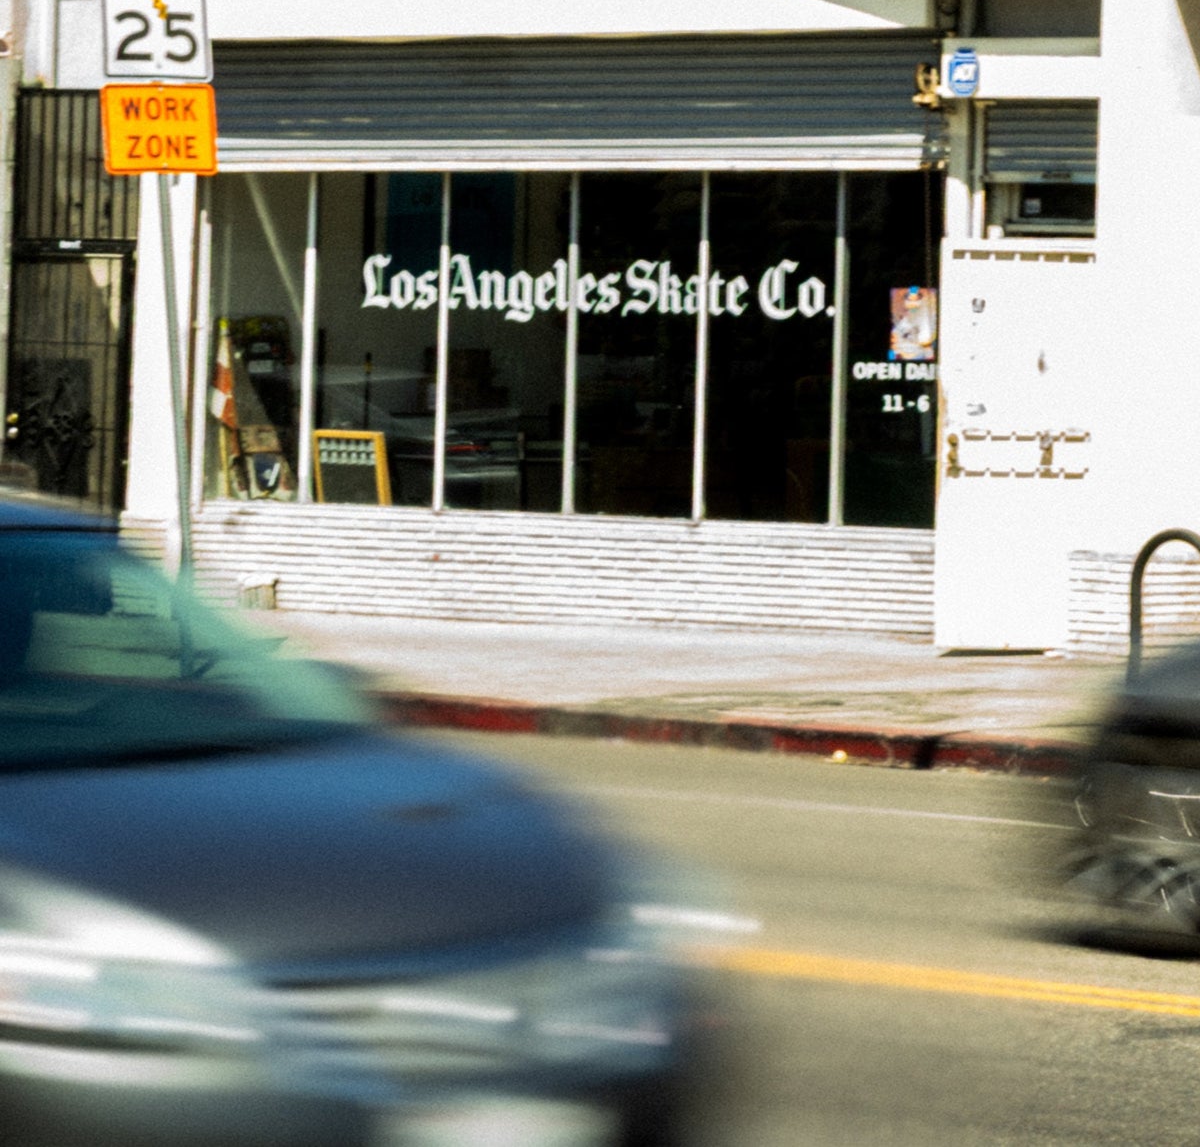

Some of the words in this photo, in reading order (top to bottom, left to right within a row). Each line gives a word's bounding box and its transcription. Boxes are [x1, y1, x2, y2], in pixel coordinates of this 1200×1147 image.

[115, 10, 199, 63] 25
[121, 97, 198, 122] WORK
[127, 134, 198, 159] ZONE
[361, 253, 440, 311] Los
[448, 253, 622, 324] Angeles
[620, 258, 750, 318] Skate
[758, 258, 837, 321] Co.
[852, 361, 902, 381] OPEN
